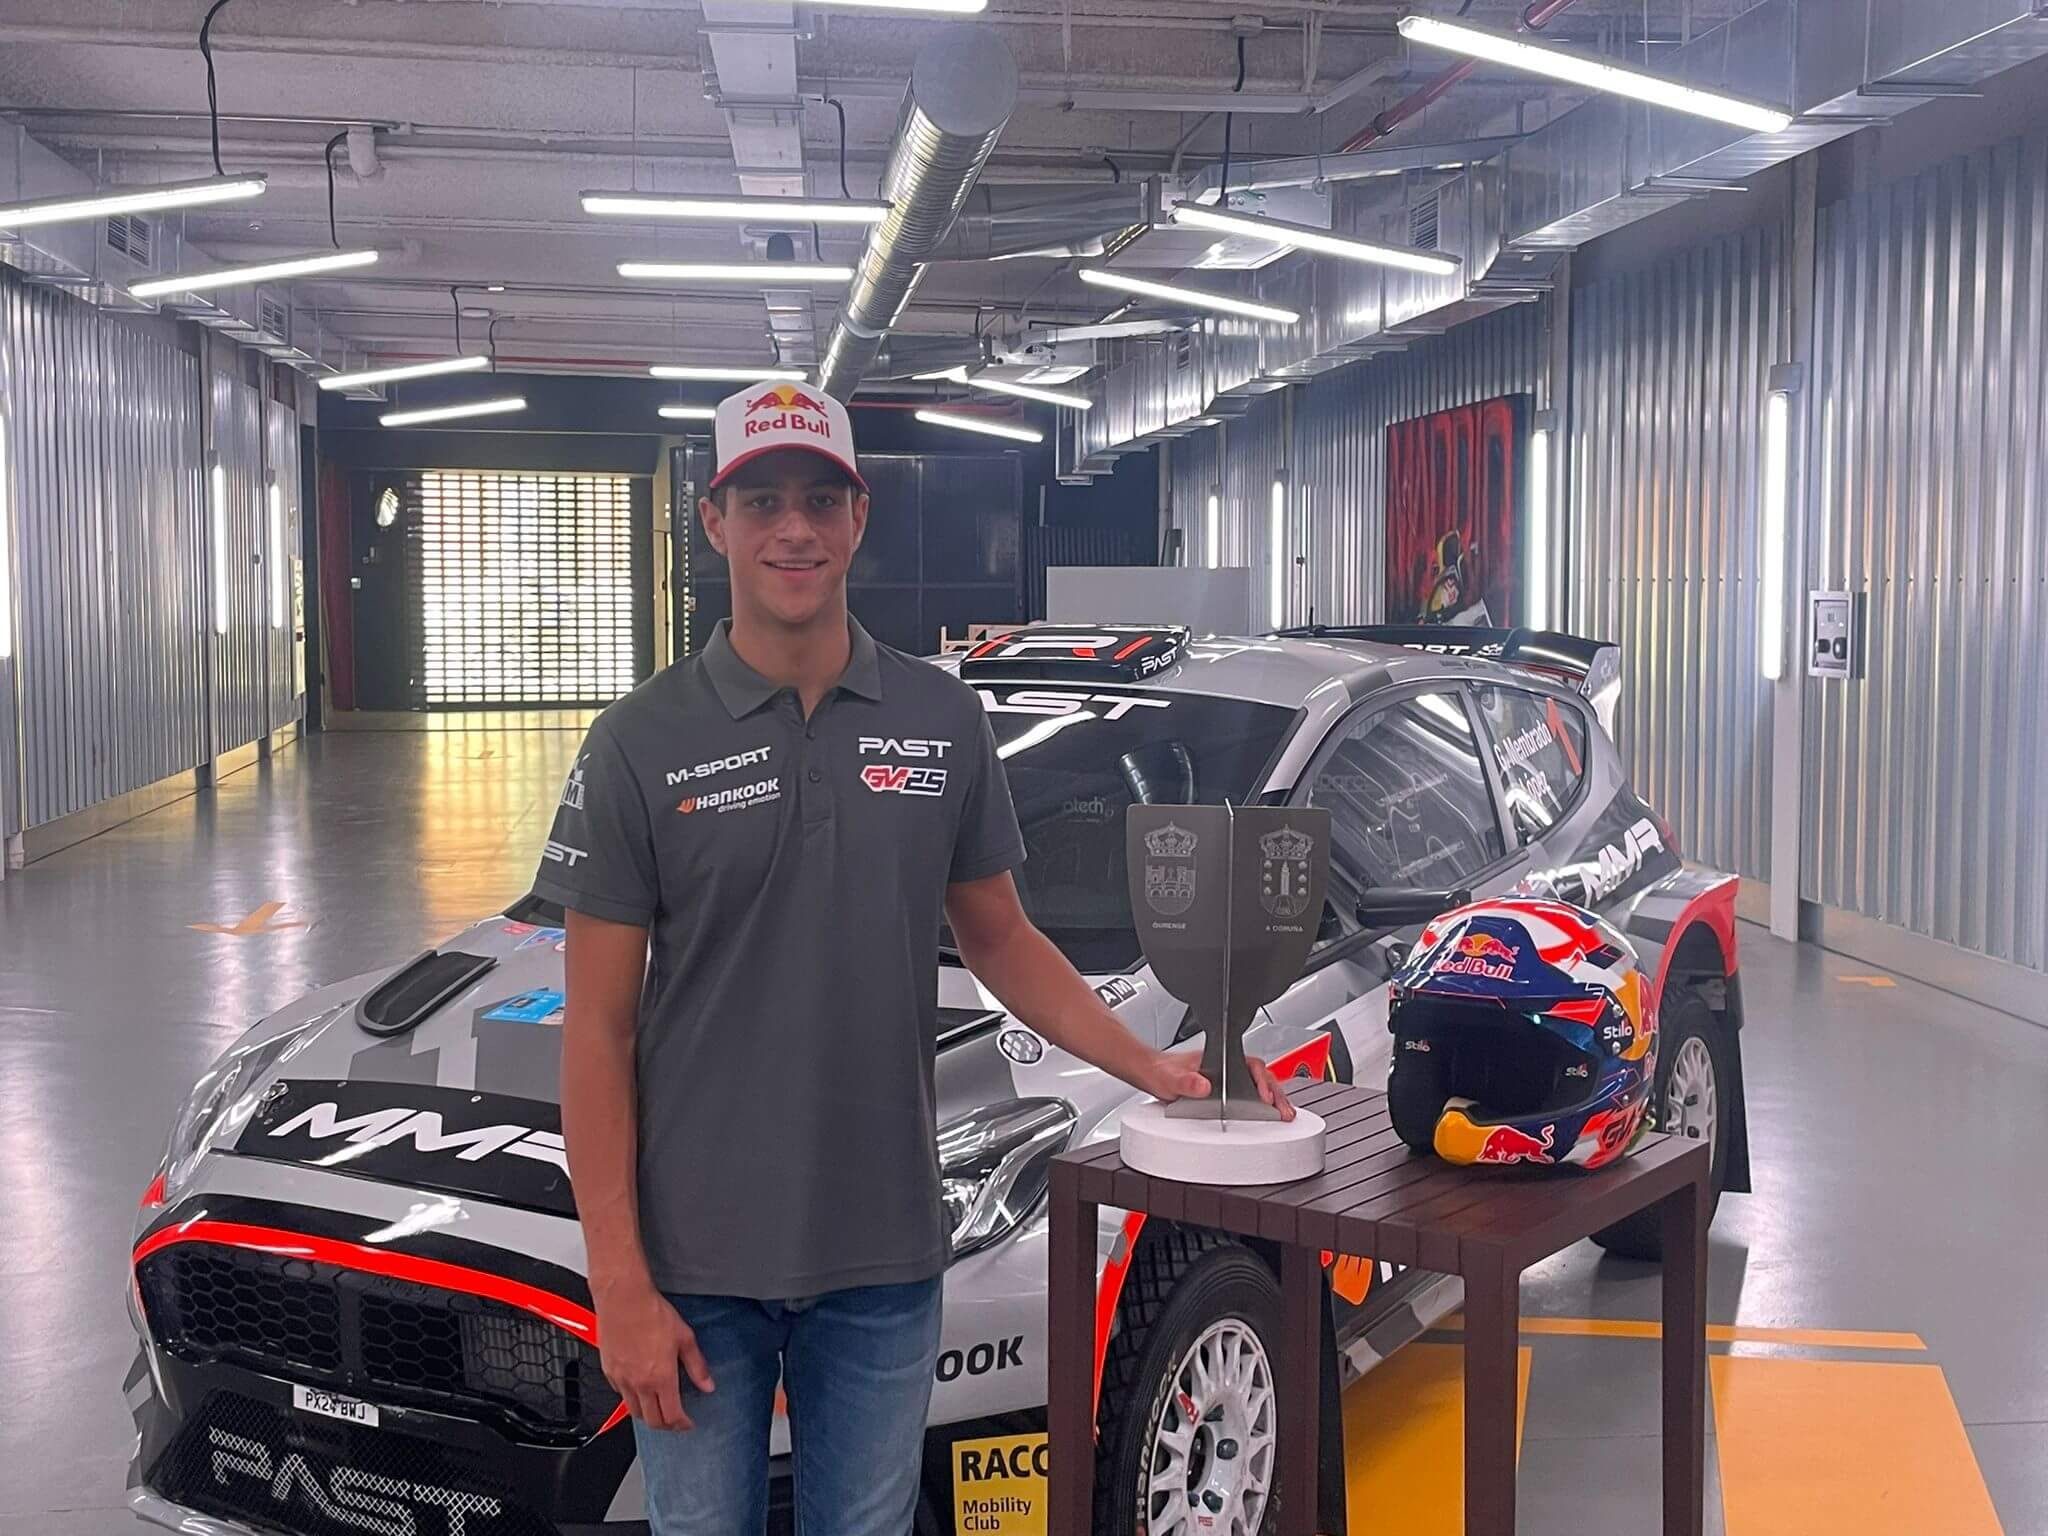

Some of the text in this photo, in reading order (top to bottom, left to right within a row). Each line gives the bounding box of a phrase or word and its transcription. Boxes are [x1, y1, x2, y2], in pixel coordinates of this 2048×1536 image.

[745, 412, 830, 438] Red Bull
[858, 736, 952, 758] PAST
[665, 746, 771, 786] M-SPORT
[717, 792, 781, 813] driving emotion
[1467, 958, 1513, 981] Bull
[1603, 1022, 1633, 1041] Stilo
[1405, 1039, 1431, 1053] Stilo
[1565, 1063, 1589, 1078] Stilo
[935, 1335, 1025, 1383] OOK
[208, 1424, 501, 1536] PAST
[963, 1497, 1032, 1516] Mobility
[963, 1516, 1000, 1531] Club
